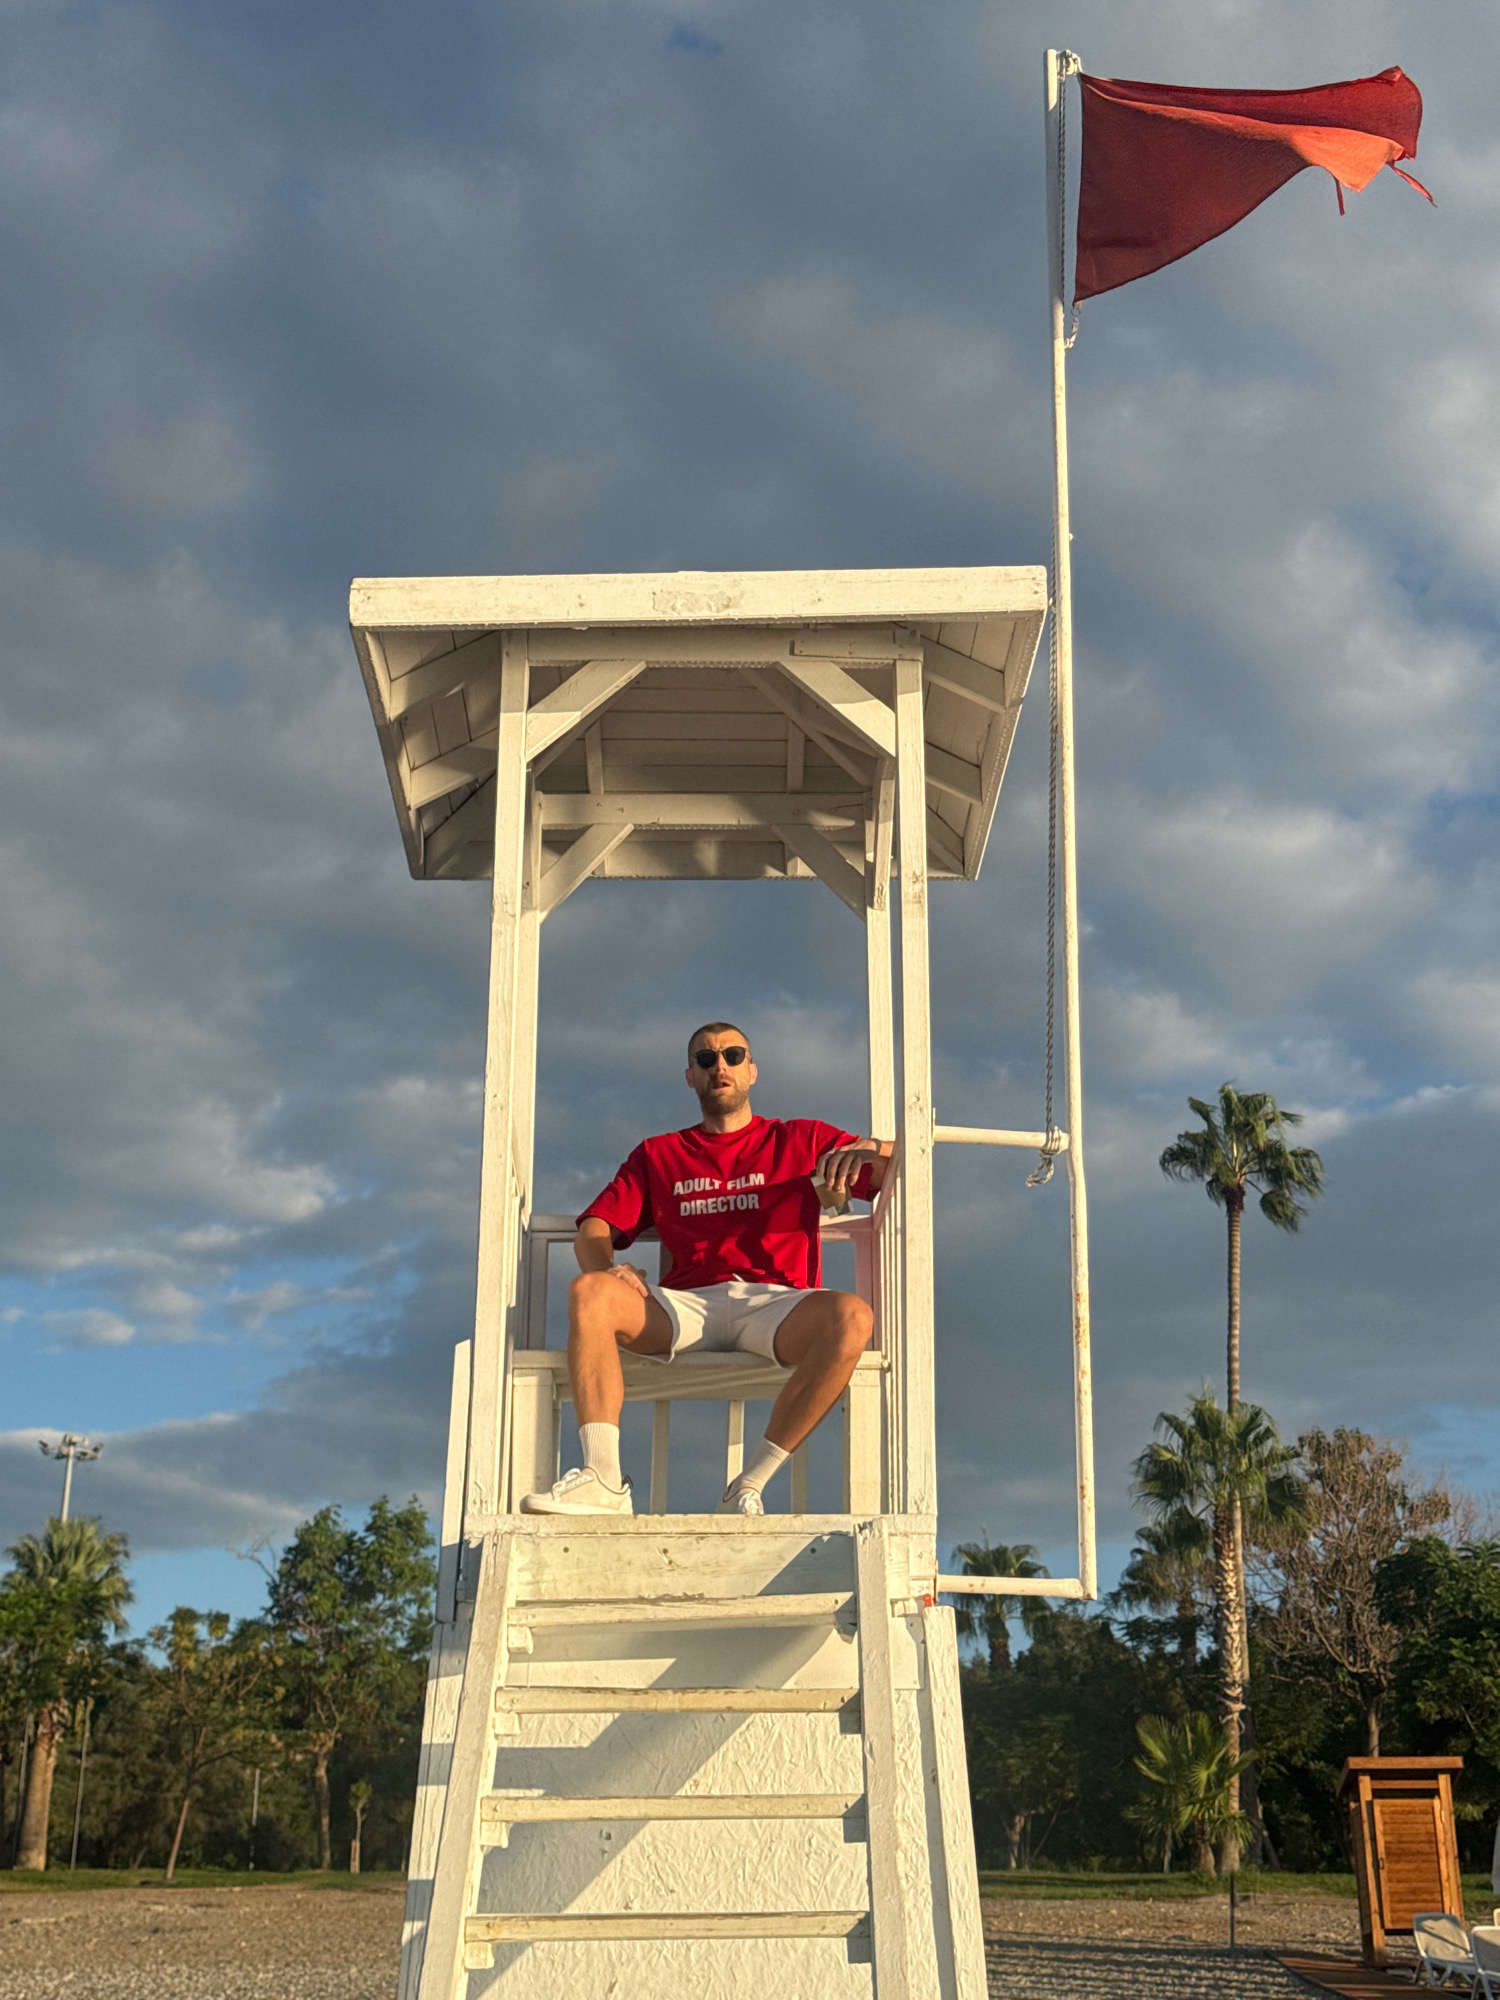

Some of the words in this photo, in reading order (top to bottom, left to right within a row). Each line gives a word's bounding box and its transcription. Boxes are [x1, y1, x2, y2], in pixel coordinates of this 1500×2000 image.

[673, 1177, 722, 1196] ADULT
[726, 1173, 765, 1190] FILM
[680, 1193, 760, 1216] DIRECTOR
